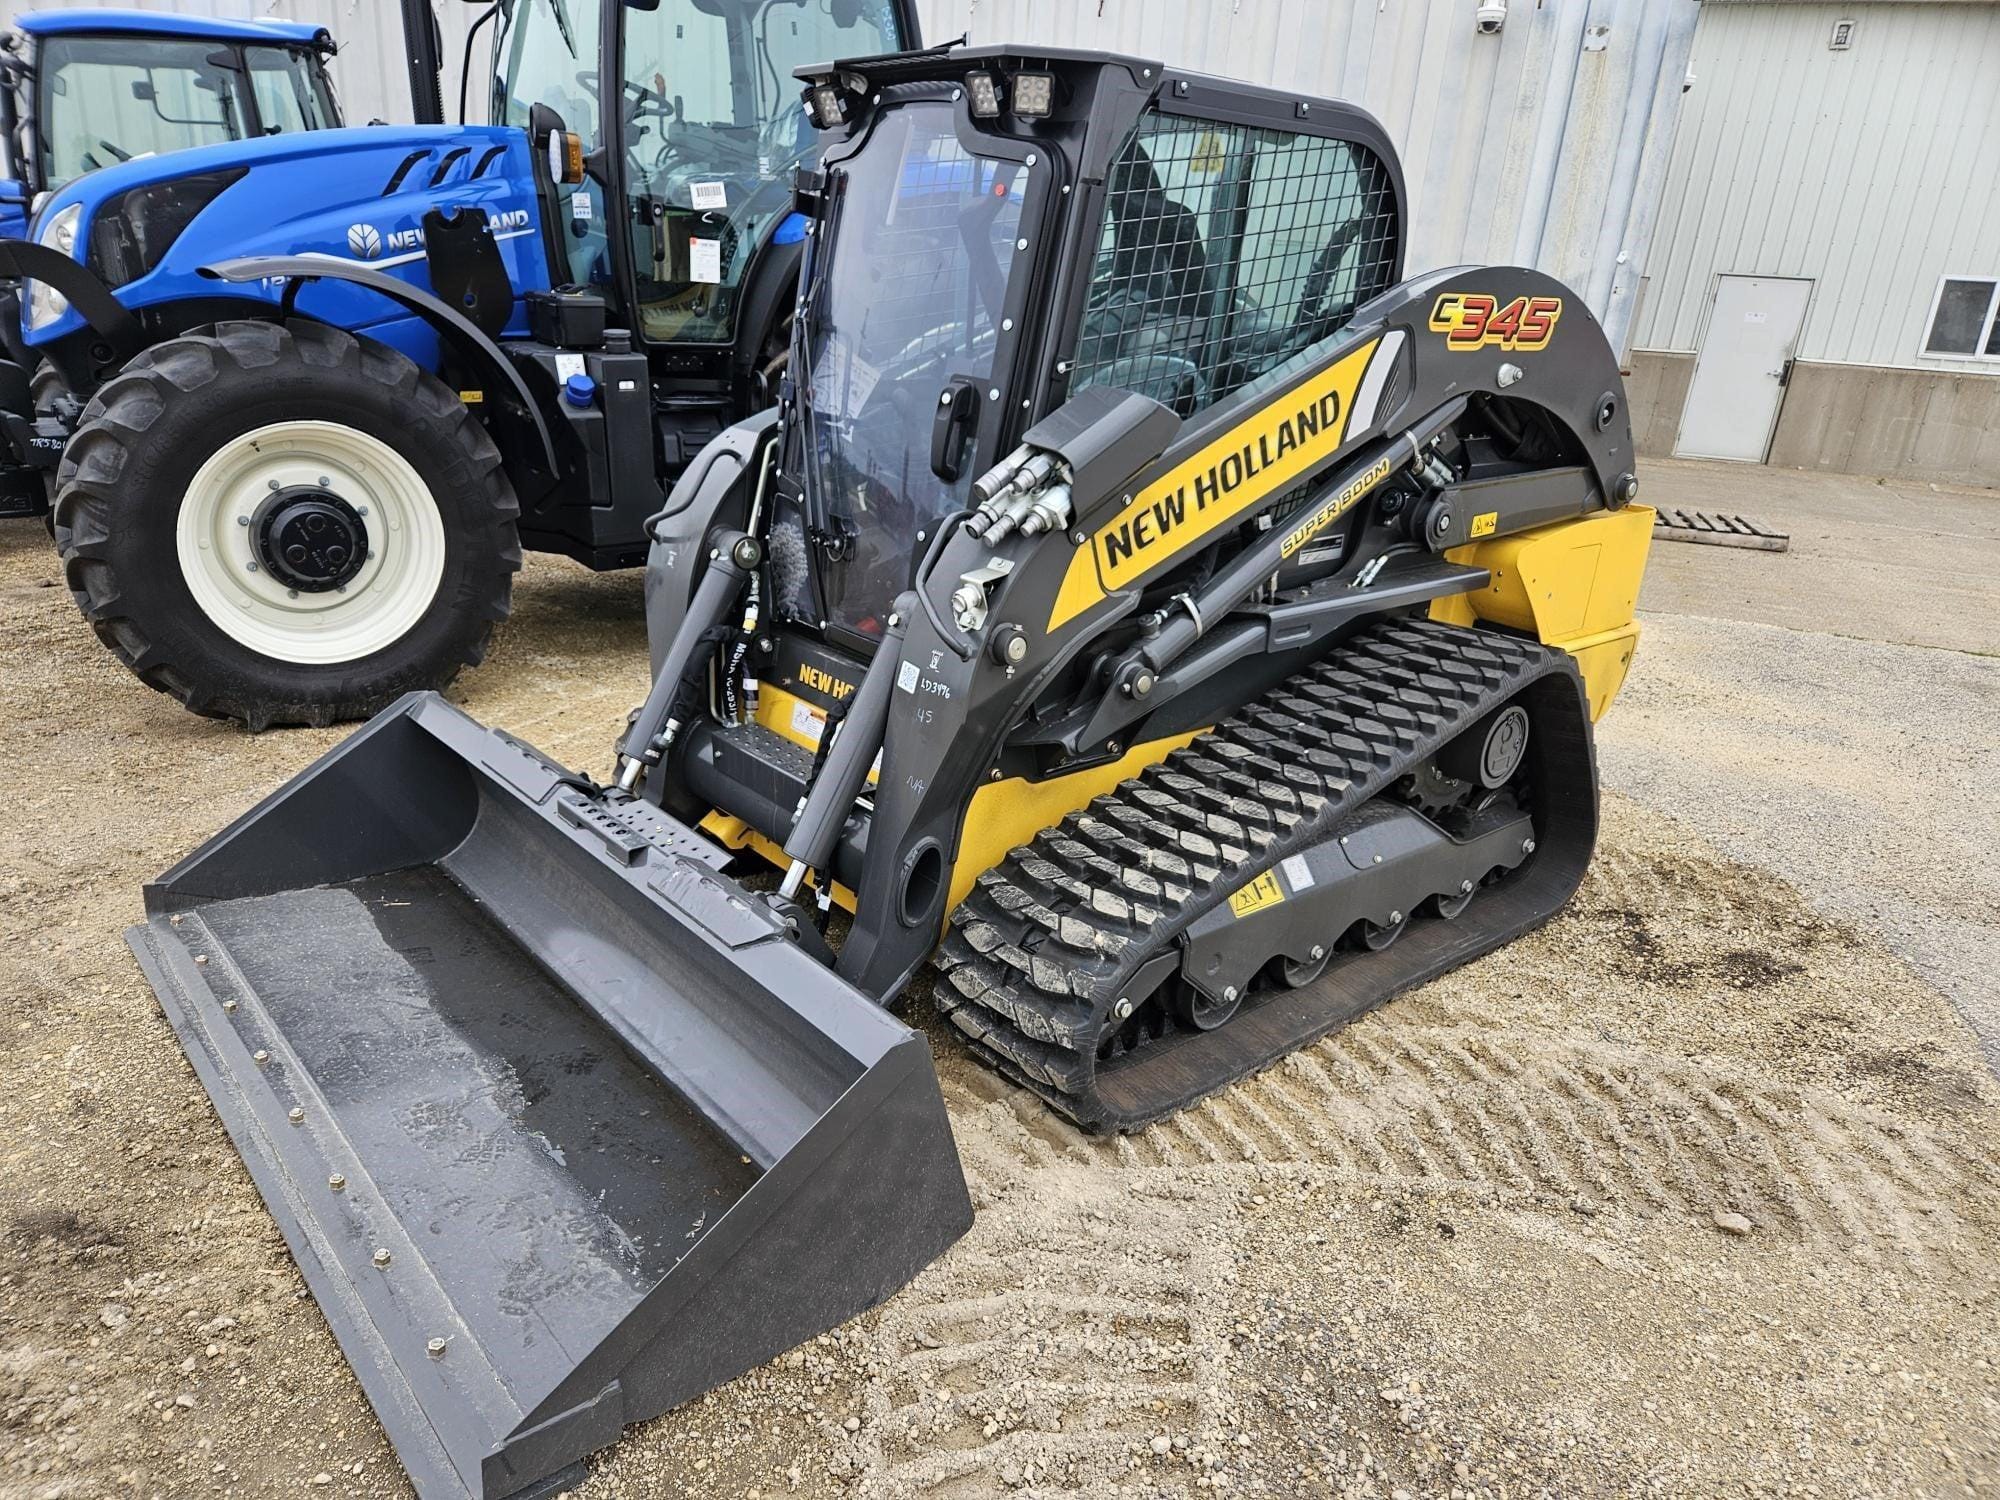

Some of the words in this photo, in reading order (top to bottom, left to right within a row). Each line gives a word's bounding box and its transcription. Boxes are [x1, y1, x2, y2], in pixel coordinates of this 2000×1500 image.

[1431, 295, 1560, 348] C345
[1104, 486, 1185, 569] NEW
[1194, 390, 1340, 511] HOLLAND
[1282, 501, 1337, 554] SUPER
[1340, 460, 1388, 506] BOOM
[799, 663, 833, 694] NEW
